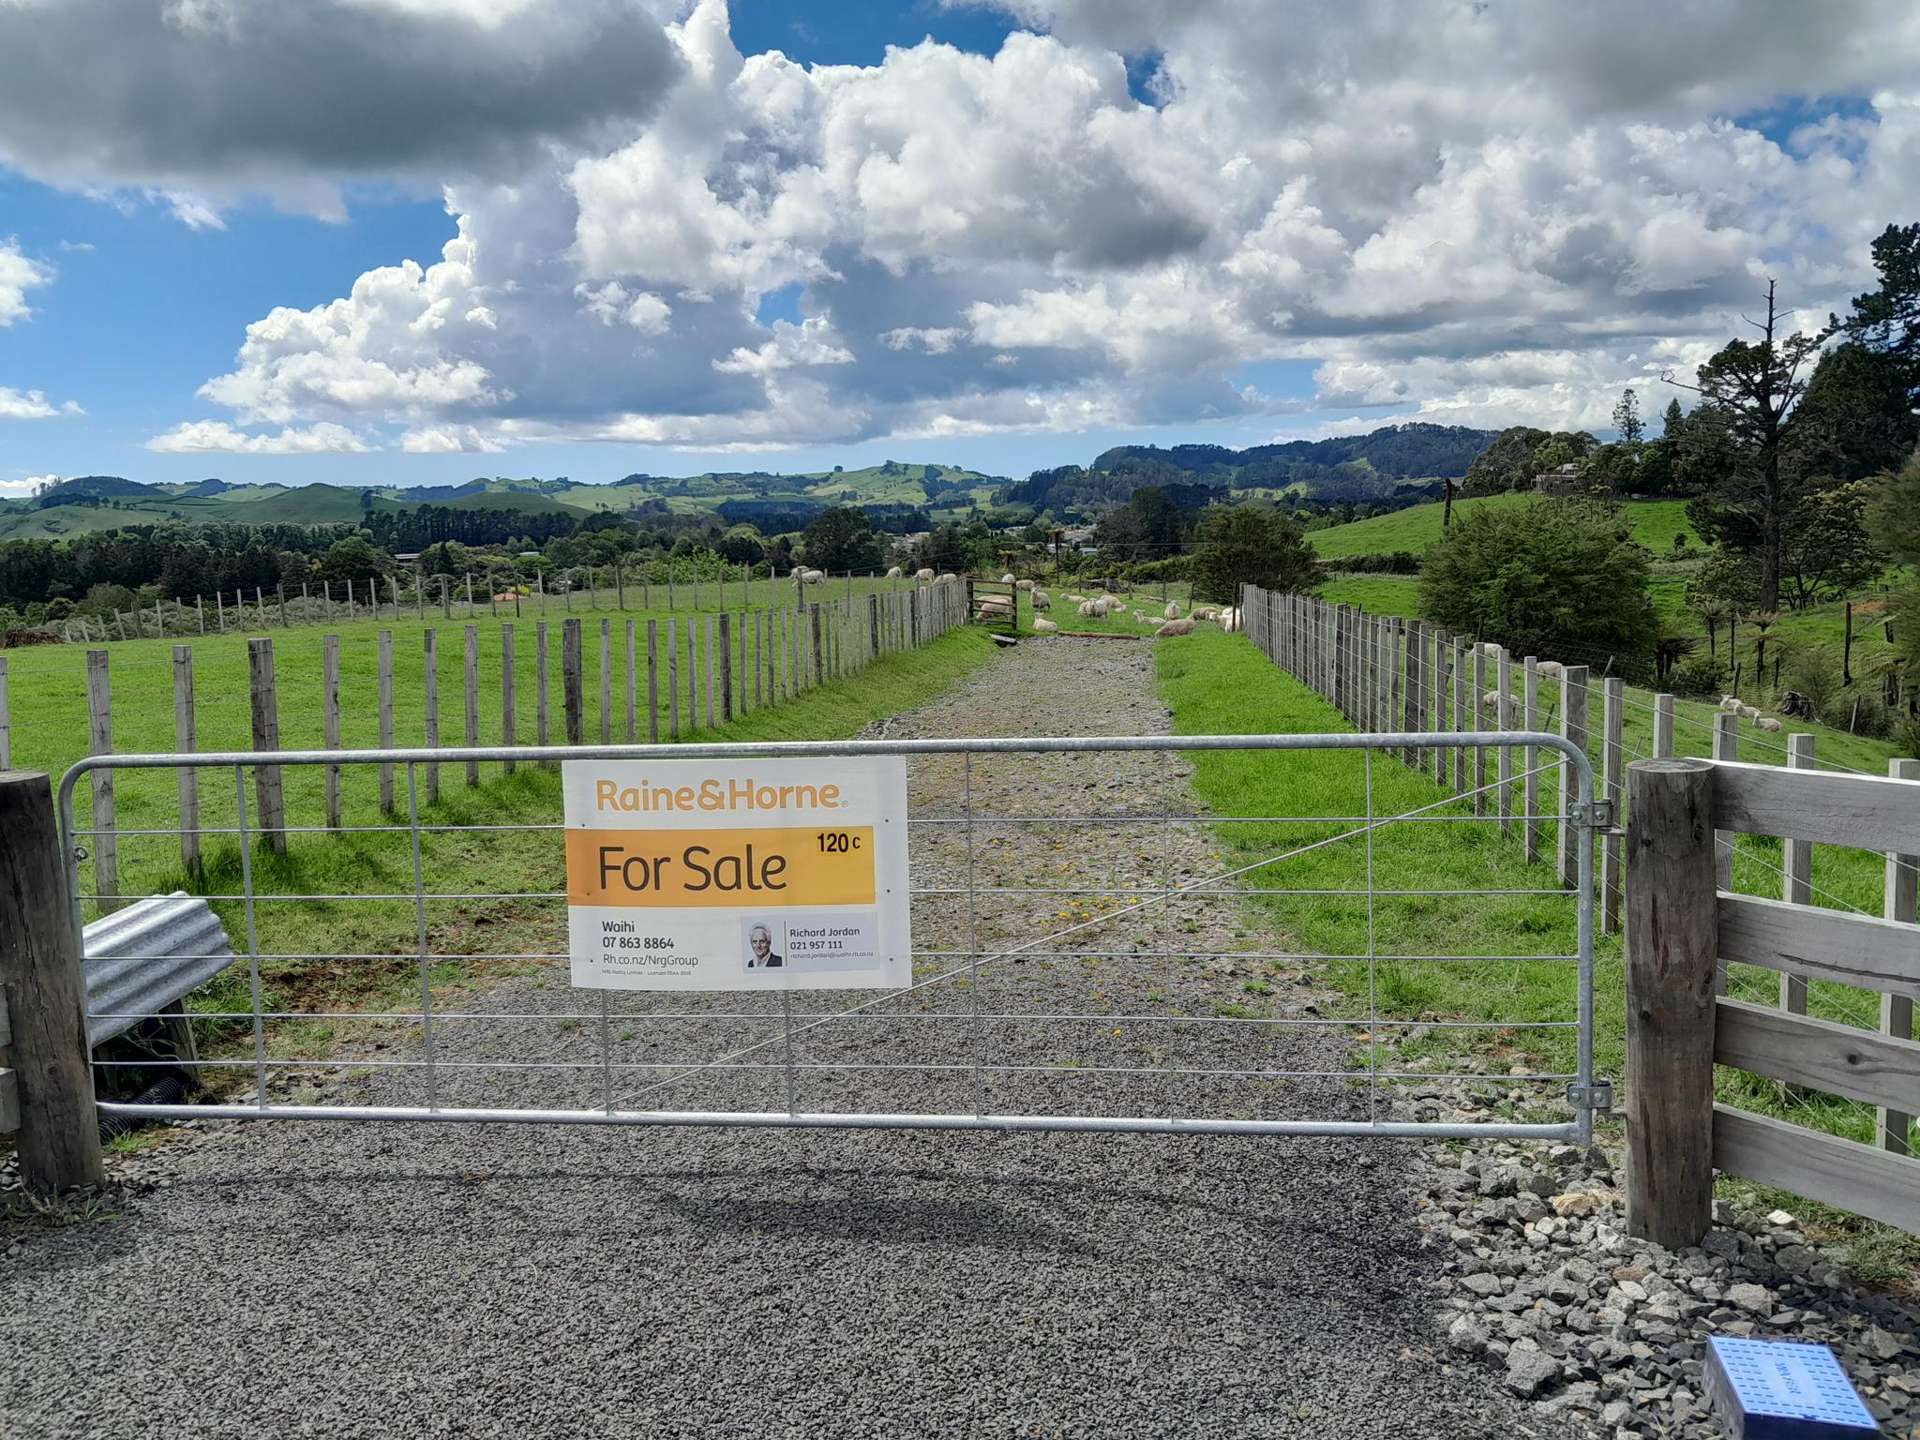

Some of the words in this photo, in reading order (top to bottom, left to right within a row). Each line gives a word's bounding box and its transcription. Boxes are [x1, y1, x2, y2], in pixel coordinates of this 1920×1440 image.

[817, 832, 849, 853] 120
[599, 846, 671, 891] For
[682, 843, 787, 891] Sale
[602, 920, 635, 933] Waihi
[790, 928, 825, 938] Richard
[828, 928, 860, 937] Jordan
[602, 936, 616, 948] 07
[619, 936, 641, 949] 863
[643, 937, 675, 949] 8864
[790, 941, 807, 950] 021
[809, 941, 825, 950] 957
[828, 941, 843, 949] 111
[602, 953, 699, 968] Rh.co.nz/NrgGroup
